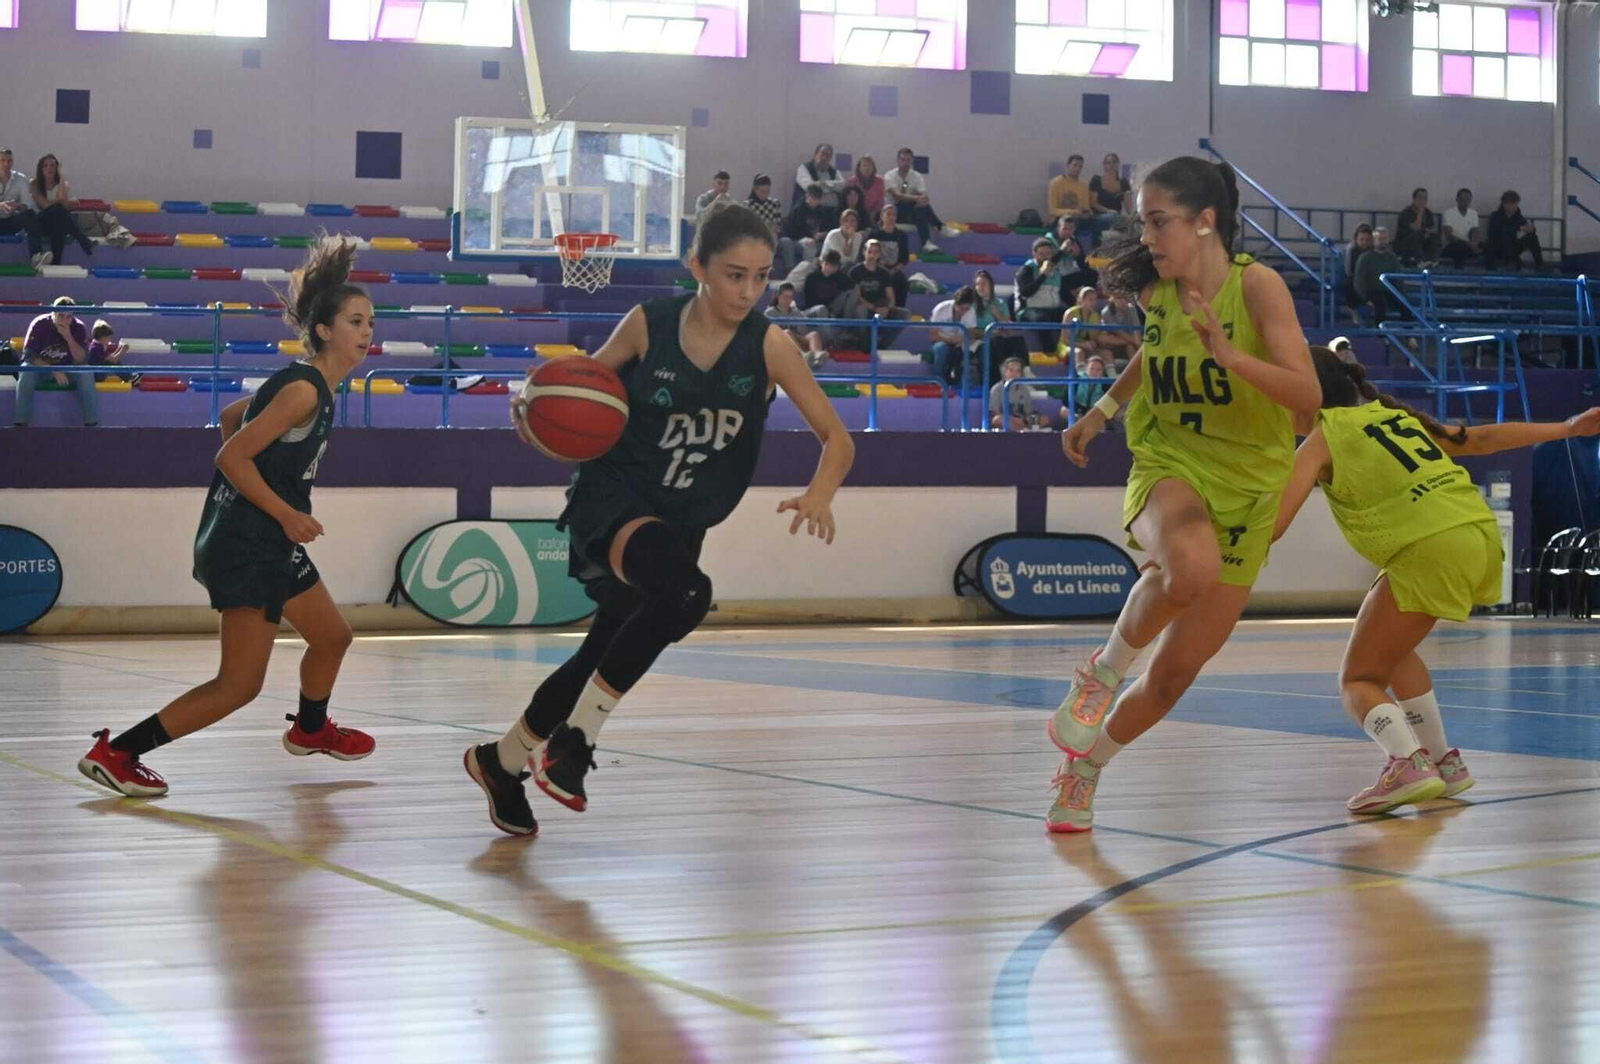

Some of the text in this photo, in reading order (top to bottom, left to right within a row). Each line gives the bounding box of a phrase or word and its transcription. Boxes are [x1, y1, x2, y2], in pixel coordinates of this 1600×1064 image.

[1149, 356, 1233, 406] MLG
[1363, 414, 1443, 474] 15
[537, 538, 569, 549] balon
[537, 550, 570, 560] andal
[1016, 561, 1127, 579] Ayuntamiento
[1033, 580, 1121, 594] de La Línea
